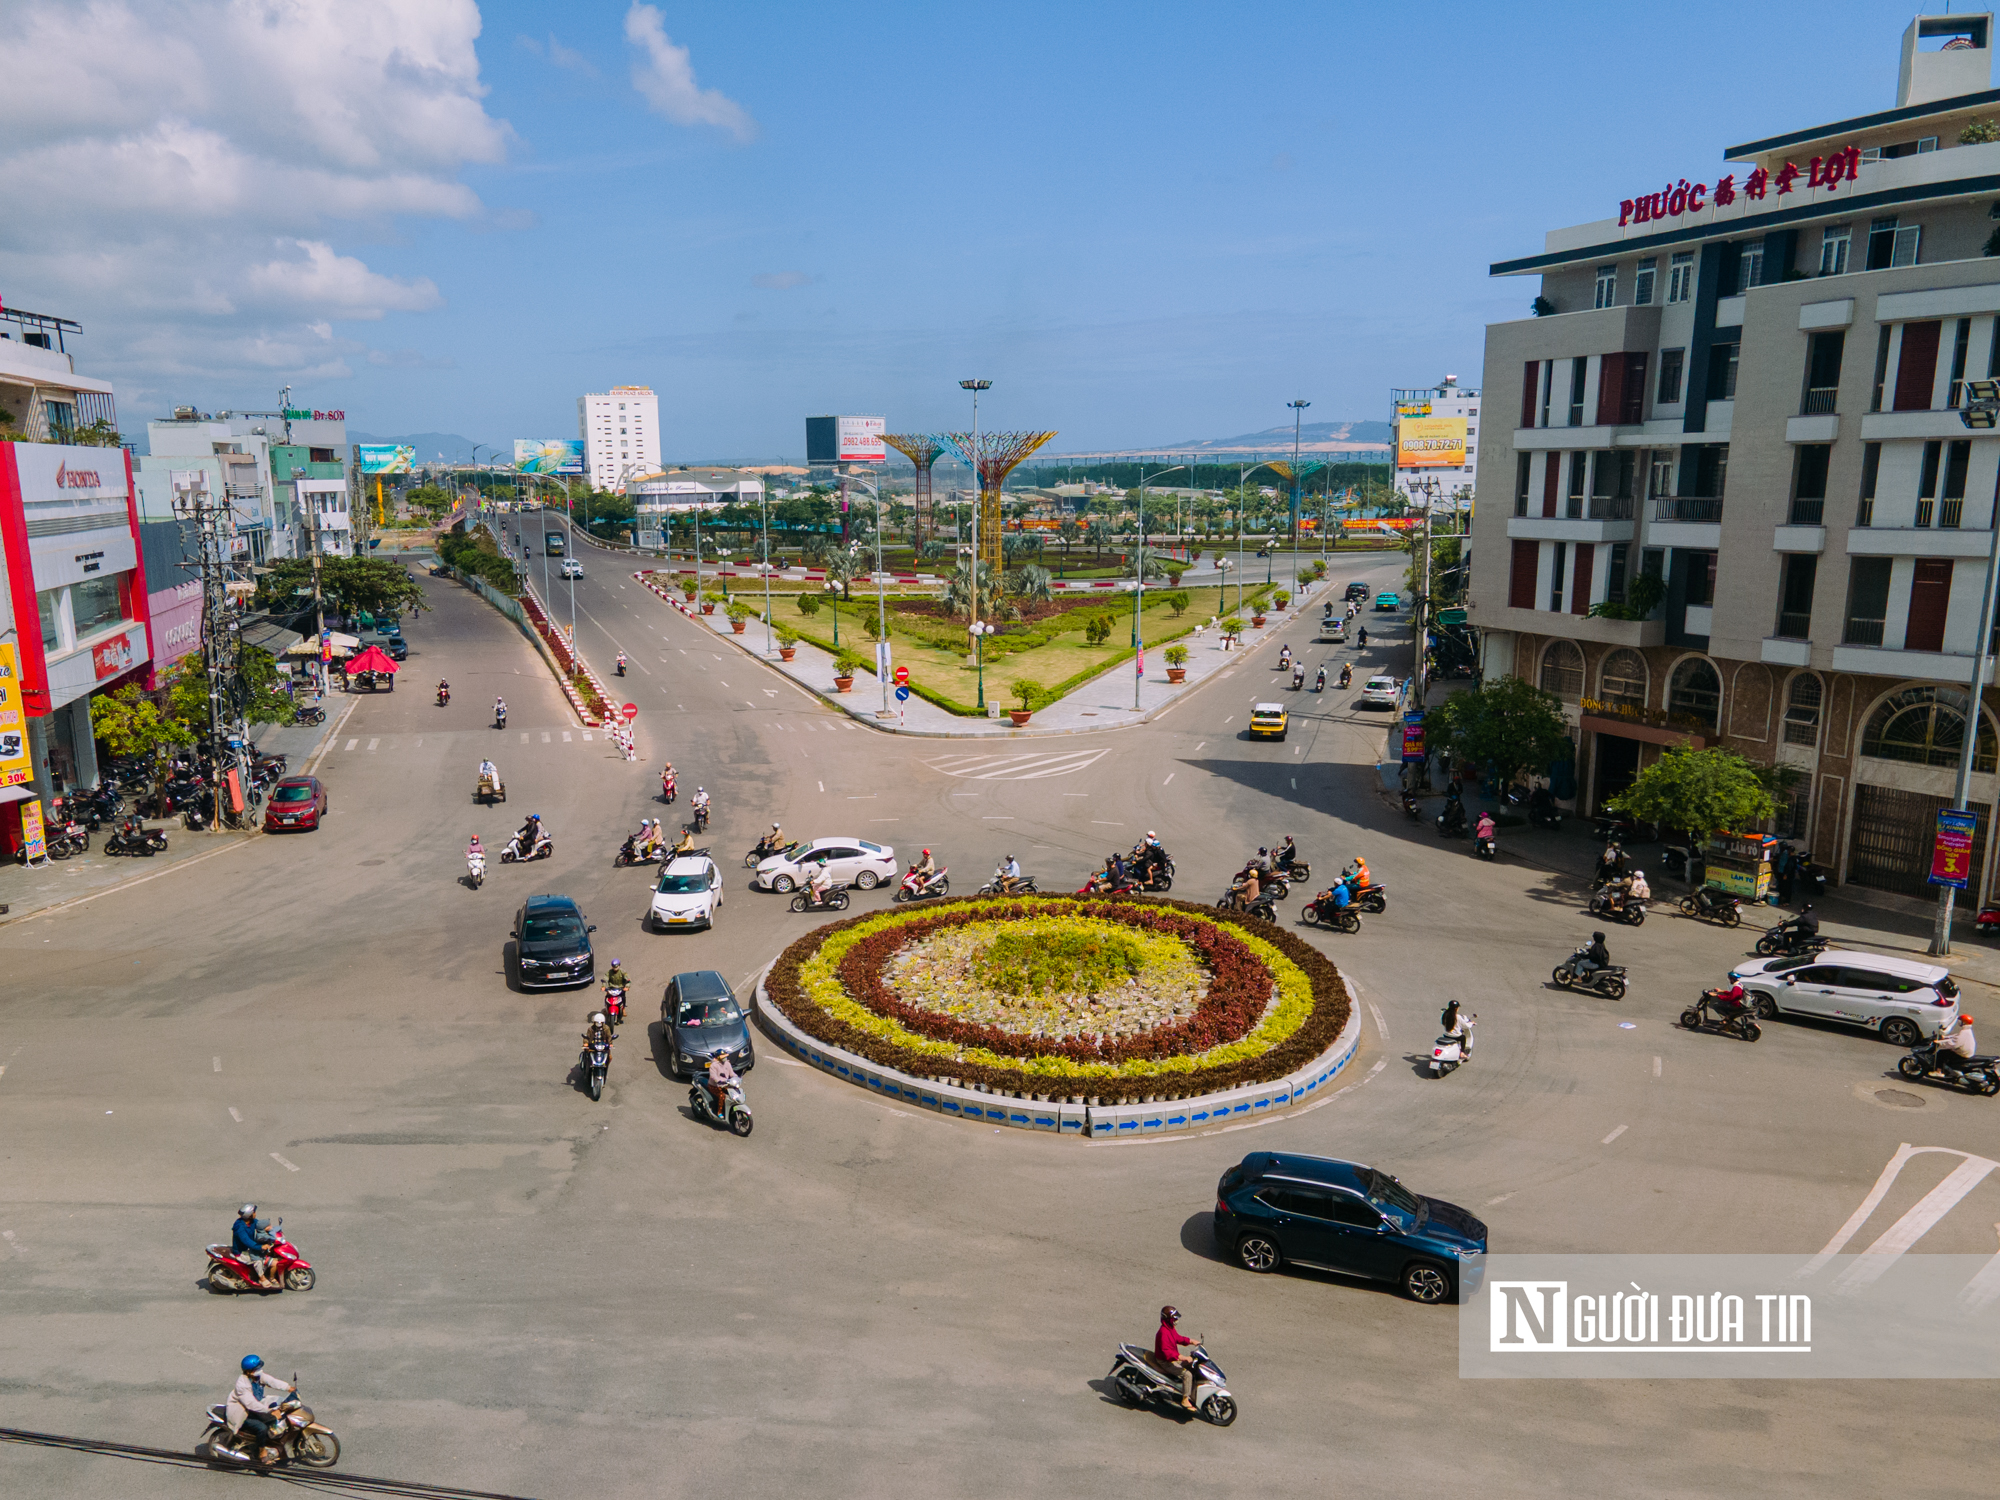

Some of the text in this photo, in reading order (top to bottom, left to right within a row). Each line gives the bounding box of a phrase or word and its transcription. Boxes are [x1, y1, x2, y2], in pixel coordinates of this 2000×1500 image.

[1807, 145, 1861, 192] LỢI
[1618, 178, 1706, 227] PHƯỚC
[1402, 439, 1462, 451] 0908.70.72.71
[66, 470, 101, 488] HONDA
[1580, 695, 1605, 711] ĐÔNG
[7, 772, 26, 784] 30K
